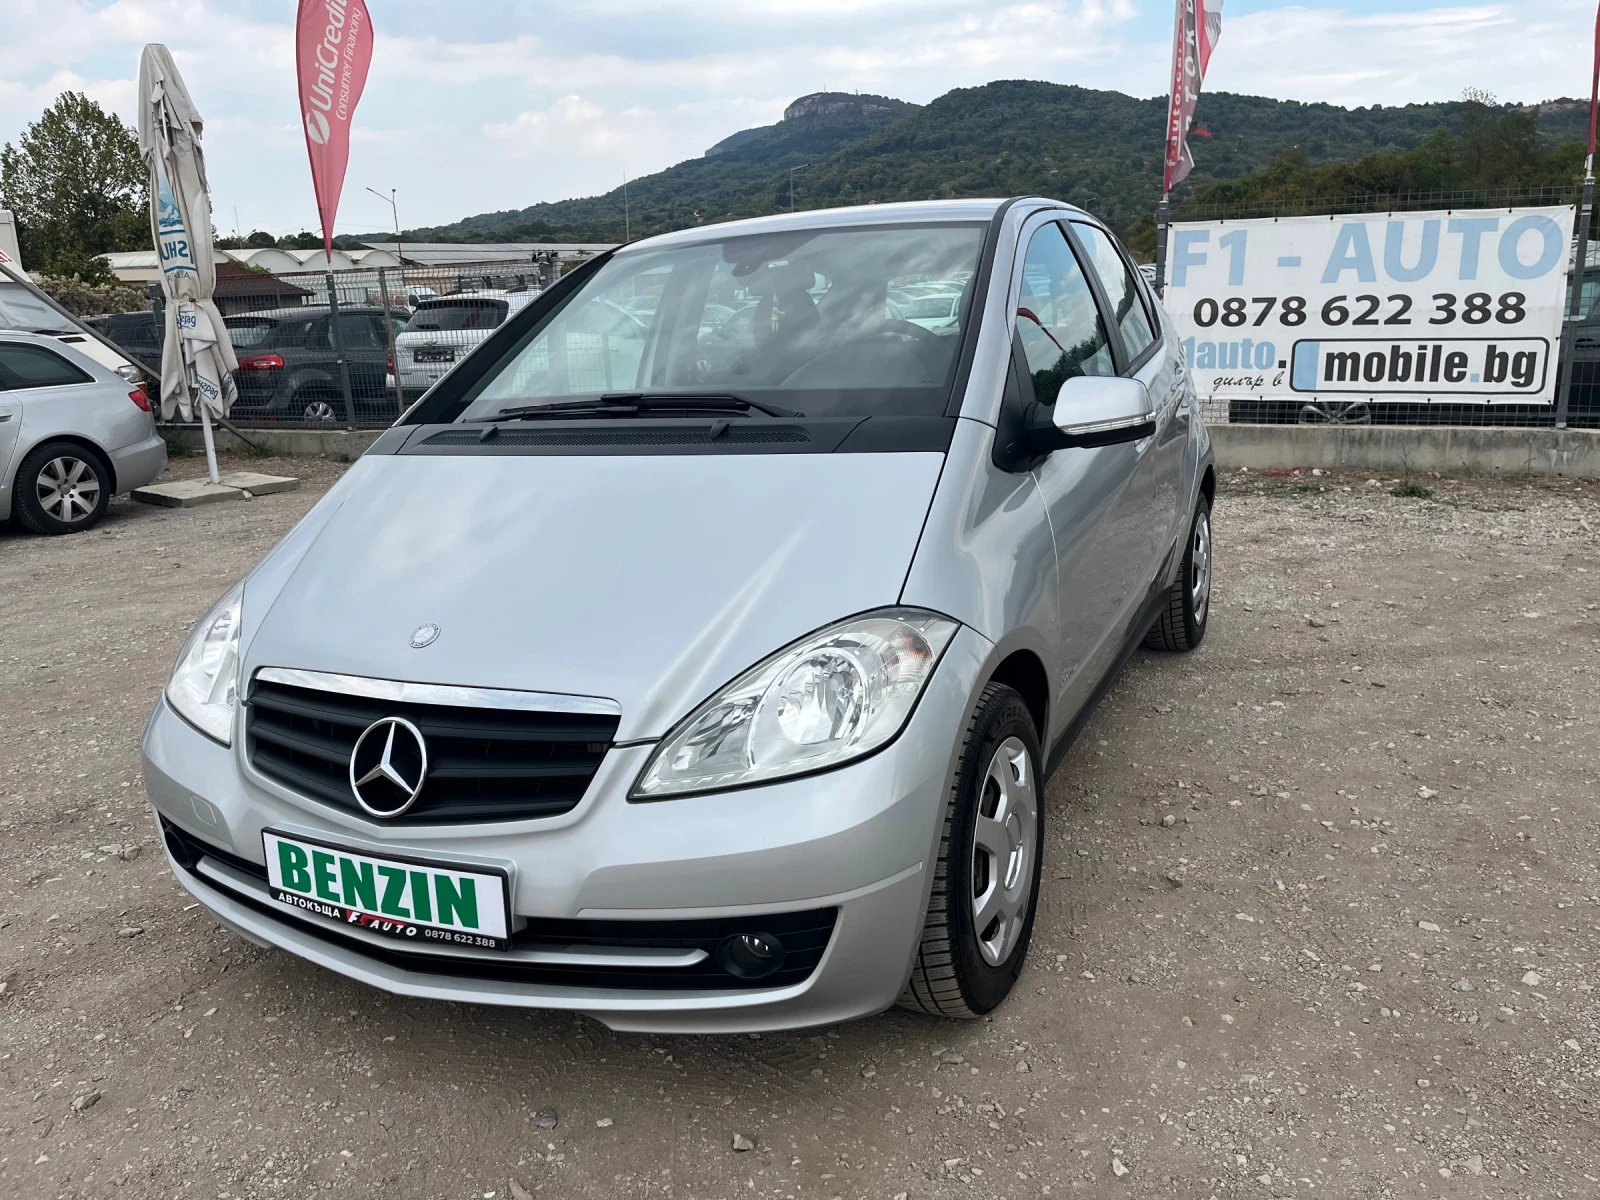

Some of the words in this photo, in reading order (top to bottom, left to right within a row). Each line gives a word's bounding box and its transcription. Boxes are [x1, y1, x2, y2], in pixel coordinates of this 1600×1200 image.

[343, 7, 363, 62] Financing
[336, 61, 352, 121] Consumer
[1171, 229, 1248, 288] F1
[1320, 215, 1563, 284] AUTO
[1193, 296, 1307, 328] 0878
[1320, 295, 1413, 326] 622
[1428, 292, 1526, 325] 388
[1324, 344, 1537, 386] mobile.bg
[277, 840, 479, 929] BENZIN
[279, 892, 340, 918] АВТОКЪЩА
[370, 919, 417, 937] AUTO
[425, 929, 452, 941] 0878
[454, 933, 473, 944] 622
[475, 937, 496, 948] 388
